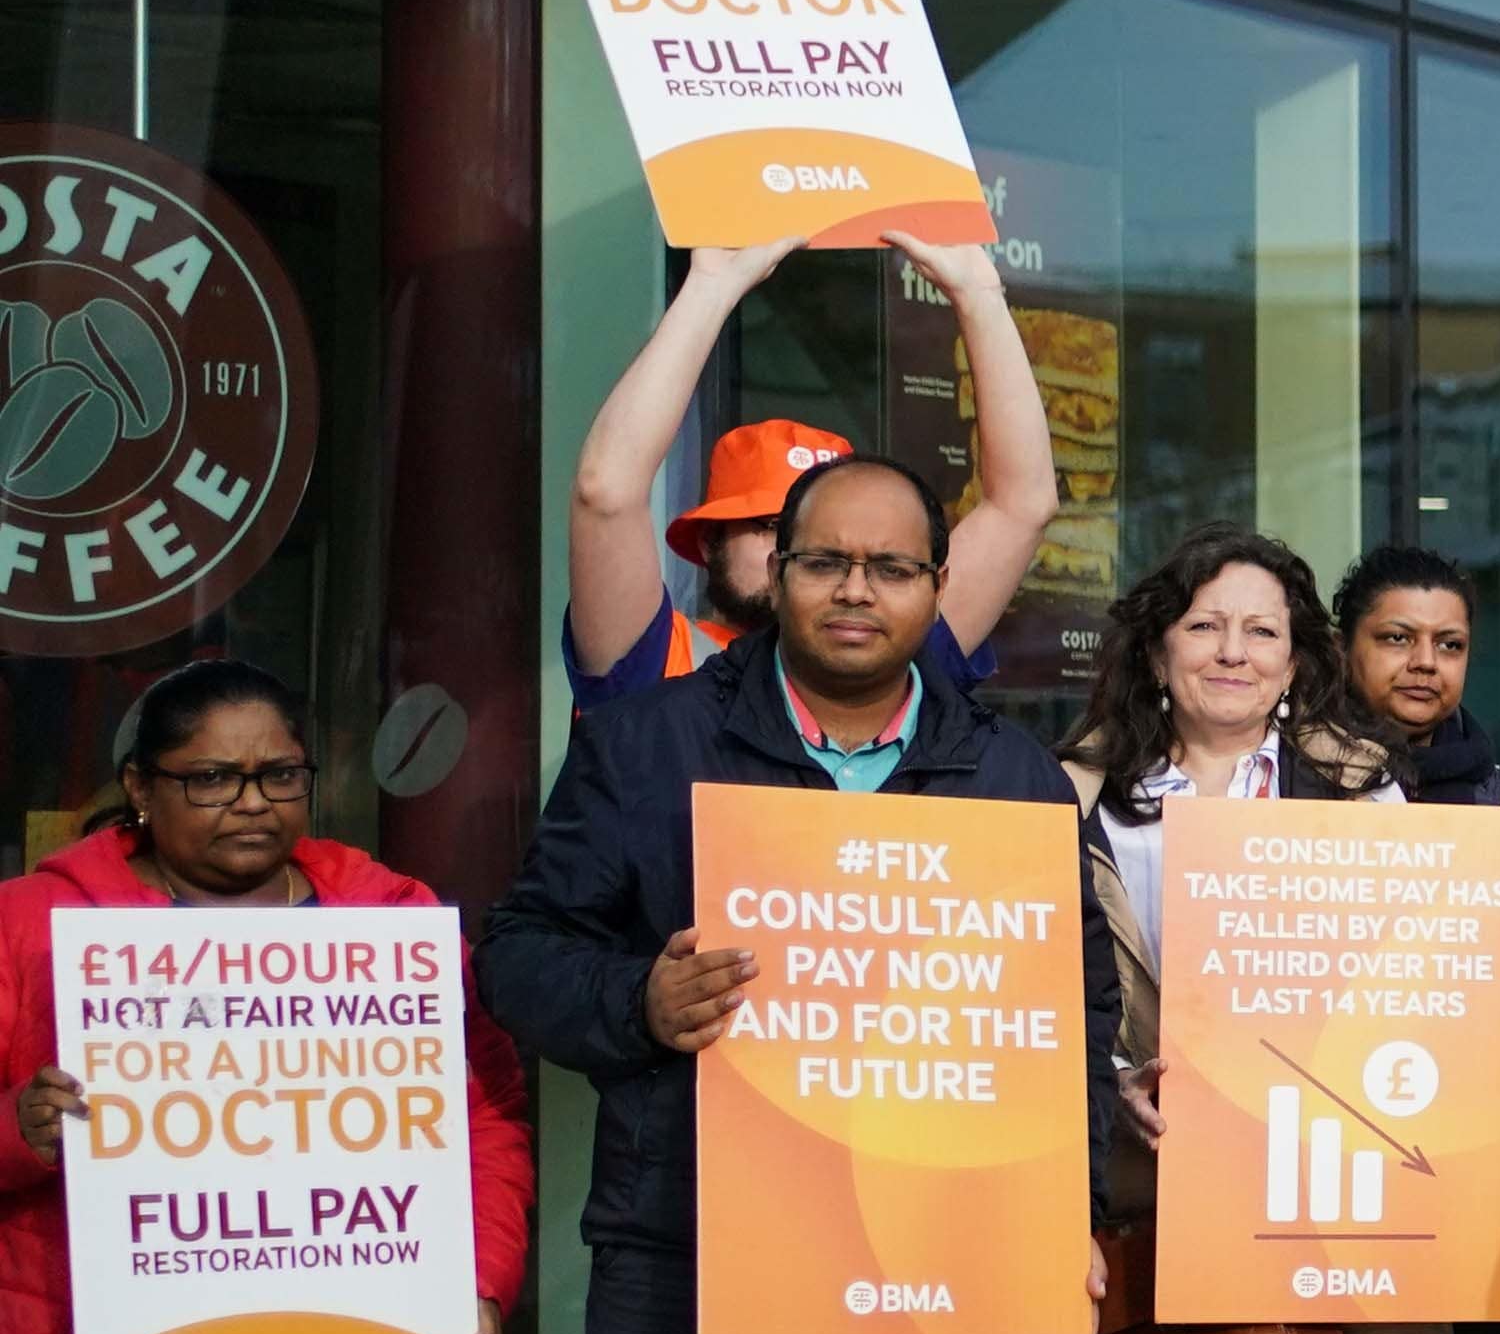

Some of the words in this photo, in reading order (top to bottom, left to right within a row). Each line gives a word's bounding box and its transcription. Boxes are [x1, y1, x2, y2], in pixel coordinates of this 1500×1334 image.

[652, 39, 794, 74] FULL
[800, 41, 889, 75] PAY
[665, 79, 841, 98] RESTORATION
[845, 80, 903, 98] NOW
[798, 166, 869, 191] BMA
[203, 362, 262, 397] 1971
[836, 839, 951, 883] #FIX
[1243, 836, 1456, 868] CONSULTANT
[1183, 872, 1377, 904] TAKE-HOME
[1384, 878, 1441, 905] PAY
[726, 887, 1056, 941] CONSULTANT
[1218, 910, 1339, 940] FALLEN
[1347, 914, 1387, 940] BY
[1393, 915, 1480, 943] OVER
[80, 938, 376, 986] £14/HOUR
[394, 940, 439, 983] IS
[786, 945, 875, 988] PAY
[888, 949, 1004, 993] NOW
[1201, 948, 1225, 975] A
[1231, 949, 1331, 977] THIRD
[1337, 951, 1425, 979] OVER
[1430, 953, 1493, 981] THE
[81, 997, 170, 1030] NOT
[182, 997, 212, 1029] A
[223, 995, 314, 1028] FAIR
[324, 993, 441, 1027] WAGE
[1231, 987, 1313, 1015] LAST
[1320, 989, 1356, 1015] 14
[1362, 989, 1466, 1018] YEARS
[729, 999, 840, 1042] AND
[852, 1003, 951, 1046] FOR
[960, 1006, 1058, 1049] THE
[84, 1040, 190, 1083] FOR
[207, 1040, 243, 1080] A
[254, 1036, 444, 1088] JUNIOR
[798, 1056, 996, 1102] FUTURE
[90, 1085, 446, 1159] DOCTOR
[129, 1190, 293, 1244] FULL
[310, 1184, 418, 1236] PAY
[132, 1247, 343, 1275] RESTORATION
[352, 1240, 420, 1266] NOW
[880, 1283, 955, 1313] BMA
[1325, 1268, 1396, 1296] BMA
